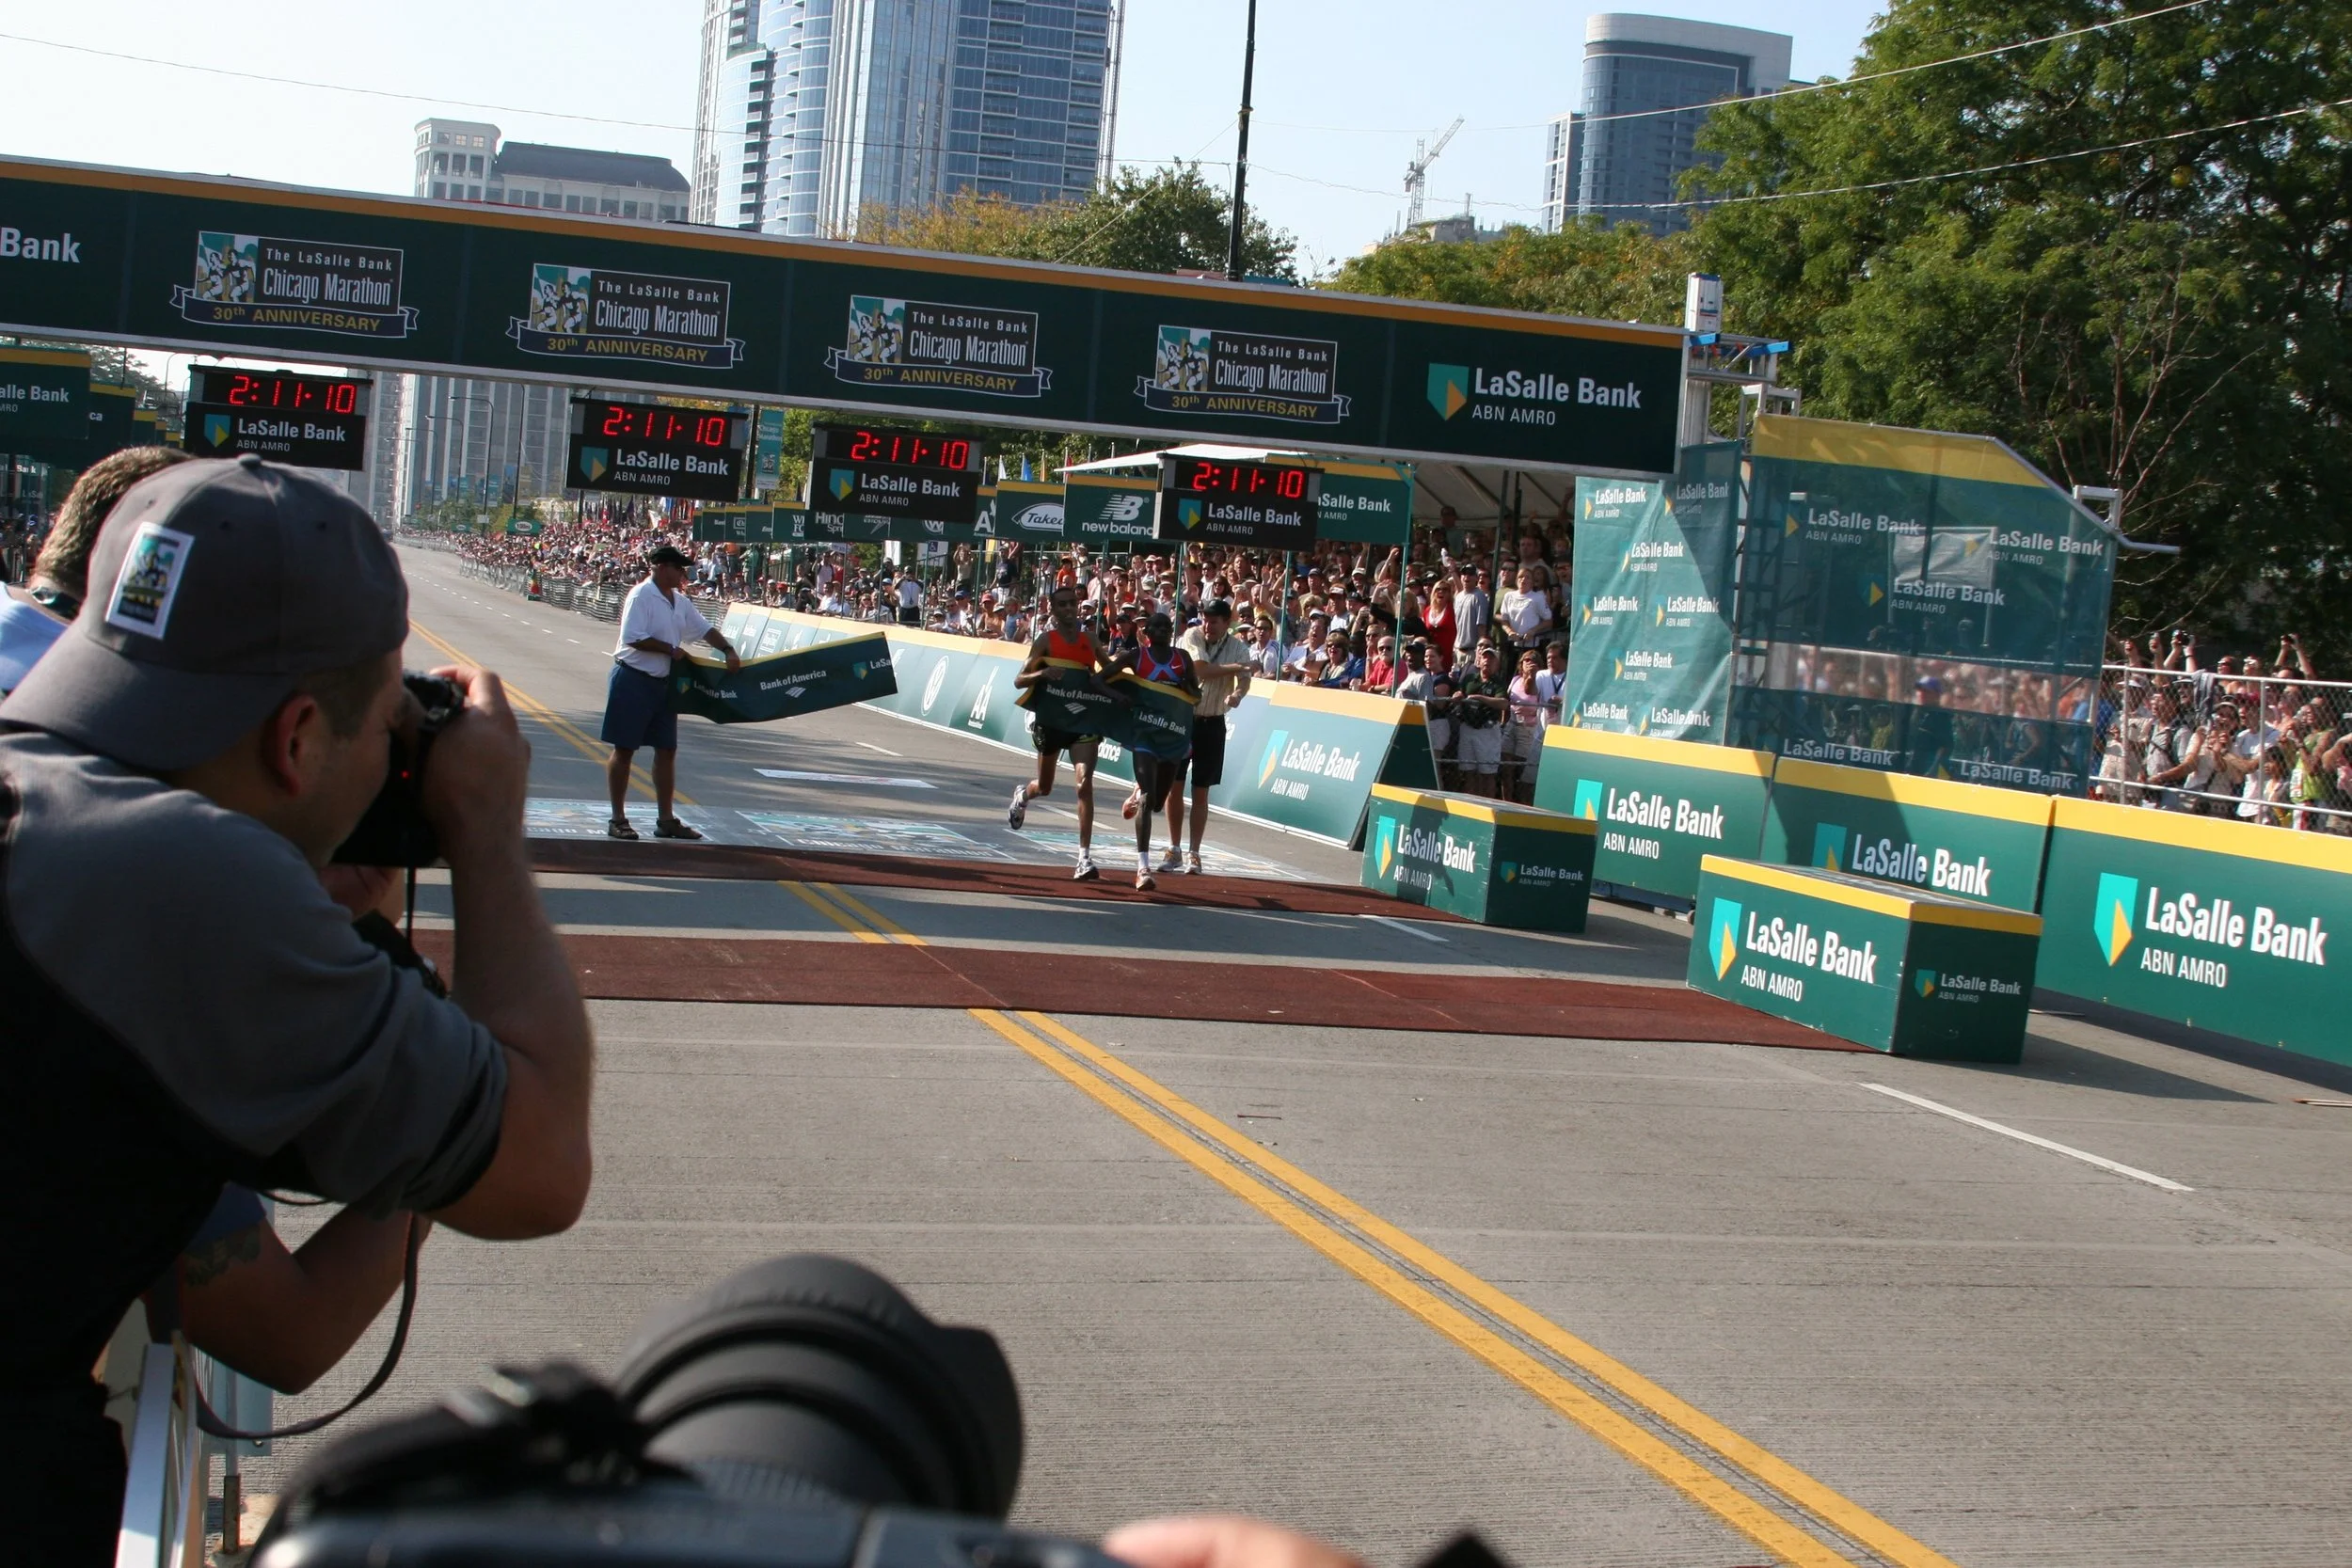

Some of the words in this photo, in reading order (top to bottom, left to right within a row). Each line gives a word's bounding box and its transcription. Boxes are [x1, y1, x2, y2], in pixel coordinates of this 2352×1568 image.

[1, 226, 81, 264] Bank
[266, 247, 291, 262] The
[298, 250, 350, 268] LaSalle
[358, 256, 393, 272] Bank
[263, 268, 319, 304] Chicago
[325, 274, 391, 306] Marathon
[598, 279, 622, 294] The
[629, 284, 679, 300] LaSalle
[688, 288, 720, 304] Bank
[213, 306, 246, 322] 30th
[252, 309, 380, 332] ANNIVERSARY
[596, 299, 649, 335] Chicago
[655, 306, 719, 338] Marathon
[913, 311, 934, 325] The
[942, 314, 990, 331] LaSalle
[997, 320, 1028, 334] Bank
[548, 338, 578, 352] 30th
[586, 339, 708, 362] ANNIVERSARY
[910, 330, 961, 366] Chicago
[966, 335, 1026, 367] Marathon
[1217, 341, 1239, 355] The
[1246, 343, 1293, 359] LaSalle
[1298, 348, 1328, 362] Bank
[864, 367, 893, 381] 30th
[900, 369, 1017, 391] ANNIVERSARY
[1216, 359, 1264, 393] Chicago
[1268, 364, 1327, 394] Marathon
[1475, 368, 1569, 402] LaSalle
[1578, 378, 1642, 408] Bank
[30, 386, 70, 403] Bank
[1172, 395, 1200, 409] 30th
[1206, 397, 1318, 419] ANNIVERSARY
[1471, 404, 1505, 421] ABN
[1510, 407, 1556, 427] AMRO
[238, 418, 299, 438] LaSalle
[305, 422, 346, 442] Bank
[236, 439, 258, 450] ABN
[261, 440, 291, 452] AMRO
[616, 448, 680, 471] LaSalle
[686, 455, 729, 476] Bank
[614, 471, 636, 483] ABN
[640, 473, 671, 486] AMRO
[861, 473, 917, 494] LaSalle
[922, 479, 961, 498] Bank
[1677, 483, 1706, 499] LaSalle
[1708, 481, 1729, 498] Bank
[859, 494, 879, 504] ABN
[882, 495, 910, 508] AMRO
[1358, 497, 1391, 513] Bank
[1596, 488, 1624, 505] LaSalle
[1625, 487, 1646, 503] Bank
[1083, 521, 1108, 532] new
[1208, 502, 1262, 523] LaSalle
[1265, 509, 1302, 527] Bank
[1324, 511, 1348, 521] AMRO
[1807, 508, 1871, 531] LaSalle
[1876, 515, 1920, 535] Bank
[1206, 523, 1226, 533] ABN
[1228, 524, 1253, 535] AMRO
[1805, 531, 1828, 541] ABN
[1830, 532, 1862, 545] AMRO
[1630, 542, 1661, 558] LaSalle
[1662, 541, 1684, 557] Bank
[1989, 528, 2053, 552] LaSalle
[2058, 536, 2104, 557] Bank
[2011, 552, 2043, 565] AMRO
[1594, 595, 1616, 611] LaSalle
[1618, 595, 1638, 611] Bank
[1894, 578, 1956, 601] LaSalle
[1962, 585, 2006, 606] Bank
[1667, 596, 1696, 612] LaSalle
[1696, 596, 1720, 613] Bank
[1890, 598, 1913, 610] ABN
[1915, 600, 1947, 614] AMRO
[1626, 651, 1652, 667] LaSalle
[1653, 652, 1673, 669] Bank
[760, 677, 783, 690] Bank
[783, 675, 792, 687] of
[791, 669, 828, 684] America
[1046, 684, 1066, 698] Bank
[1066, 690, 1076, 699] of
[1076, 690, 1113, 705] America
[1138, 711, 1168, 729] LaSalle
[1582, 702, 1609, 719] LaSalle
[1610, 704, 1629, 721] Bank
[1651, 707, 1685, 725] LaSalle
[1281, 738, 1325, 774] LaSalle
[1324, 746, 1361, 783] Bank
[1784, 738, 1845, 764] LaSalle
[1850, 747, 1894, 767] Bank
[1961, 759, 2024, 784] LaSalle
[2027, 767, 2073, 790] Bank
[1270, 777, 1288, 797] ABN
[1287, 780, 1310, 802] AMRO
[1607, 786, 1672, 831] LaSalle
[1675, 798, 1724, 840] Bank
[1397, 824, 1440, 863] LaSalle
[1443, 835, 1475, 874] Bank
[1603, 832, 1627, 853] ABN
[1628, 836, 1660, 860] AMRO
[1520, 863, 1556, 879] LaSalle
[1559, 867, 1584, 881] Bank
[1851, 833, 1927, 884] LaSalle
[1931, 847, 1993, 897] Bank
[1393, 864, 1409, 883] ABN
[1409, 868, 1432, 892] AMRO
[2145, 886, 2244, 949] LaSalle
[2250, 905, 2328, 967] Bank
[1746, 911, 1818, 968] LaSalle
[1821, 930, 1878, 985] Bank
[2140, 946, 2175, 976] ABN
[2178, 954, 2228, 989] AMRO
[1740, 964, 1766, 991] ABN
[1768, 969, 1804, 1003] AMRO
[1940, 973, 1984, 992] LaSalle
[1987, 977, 2022, 996] Bank
